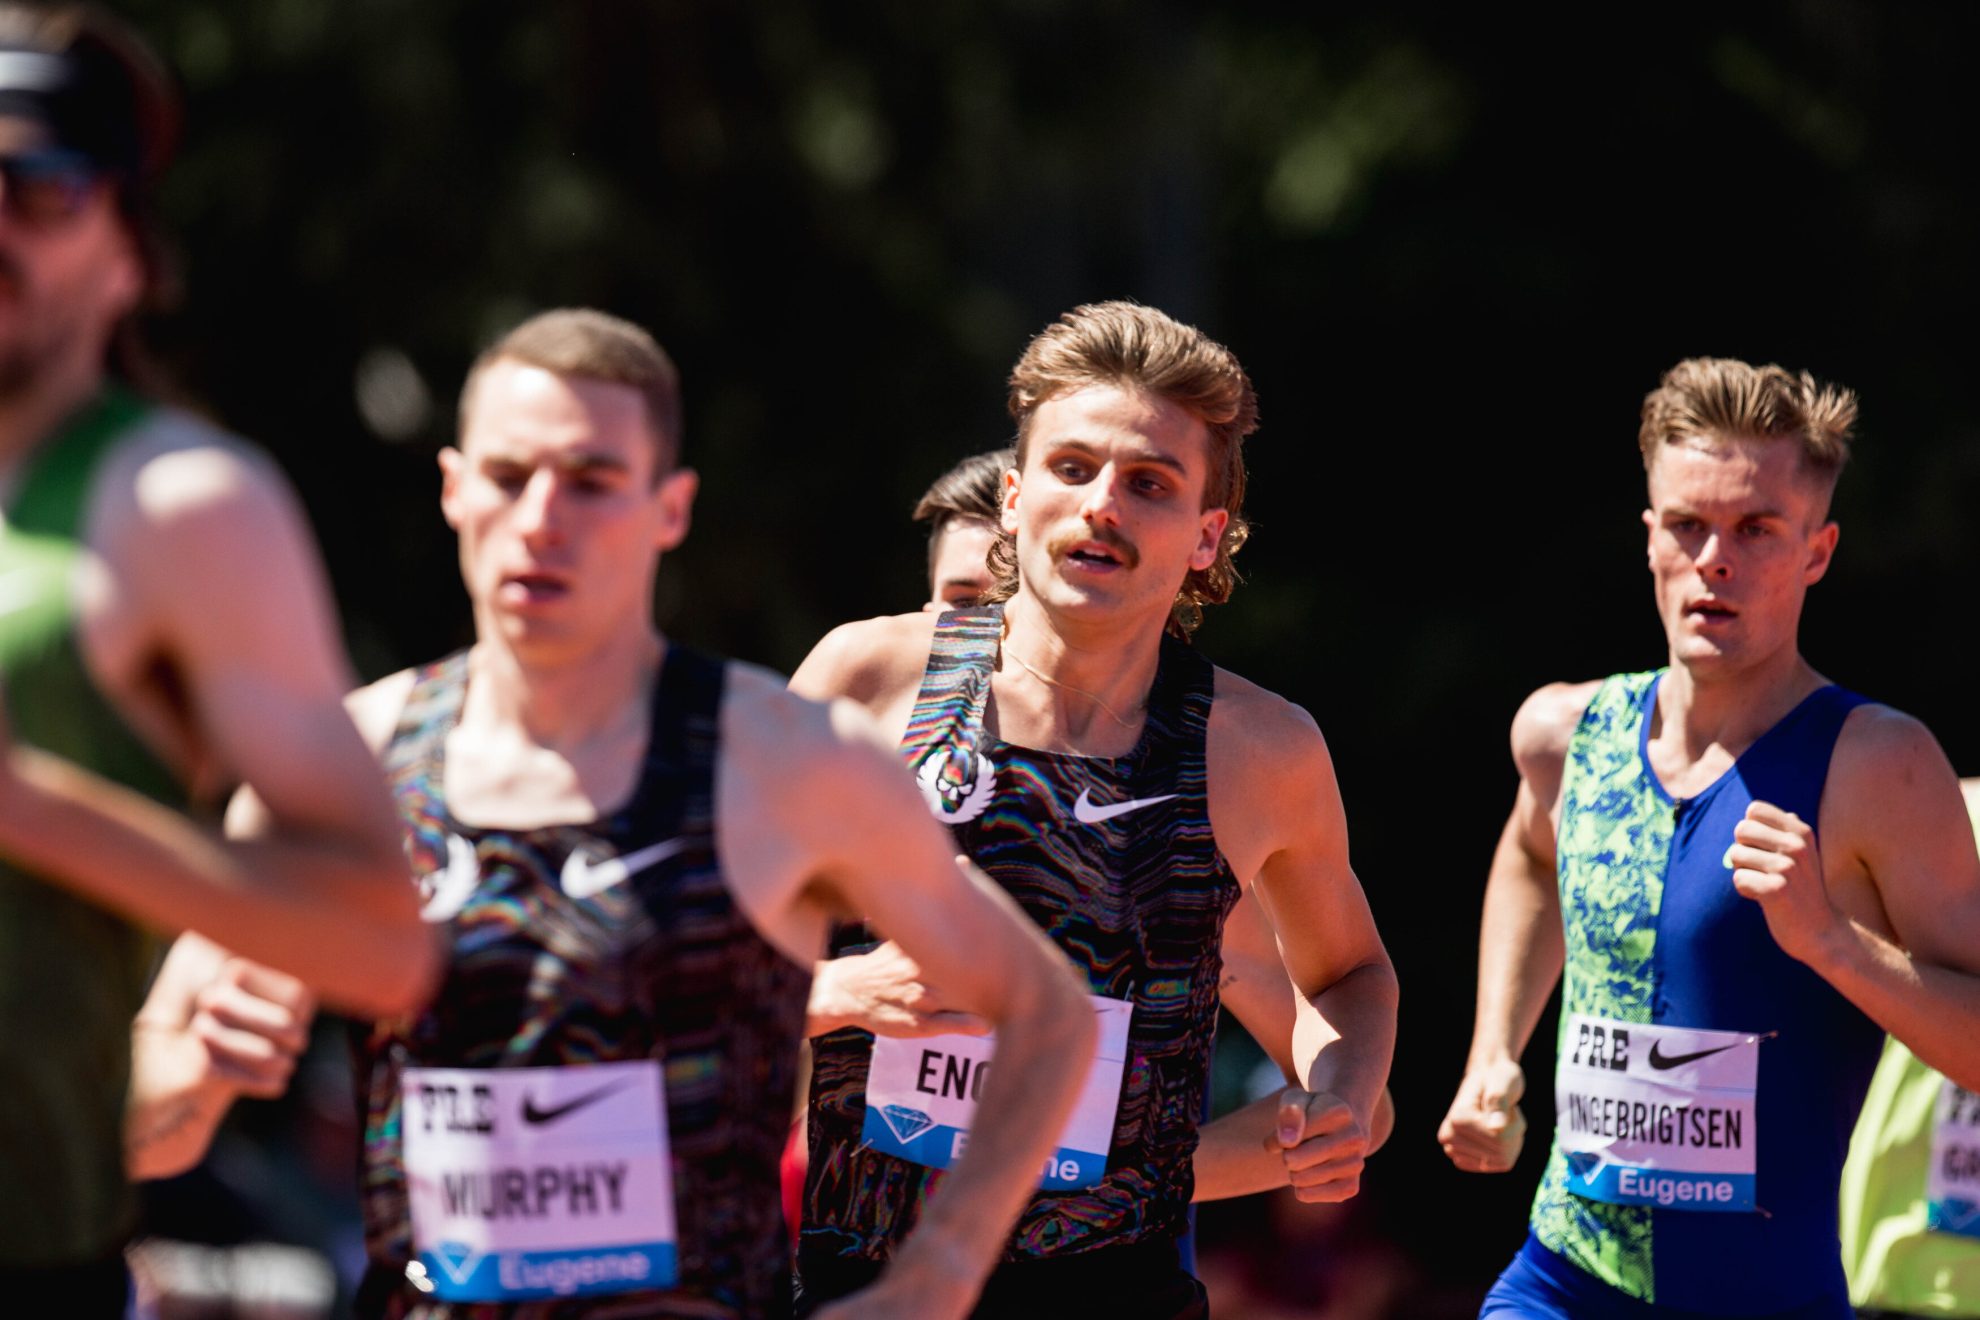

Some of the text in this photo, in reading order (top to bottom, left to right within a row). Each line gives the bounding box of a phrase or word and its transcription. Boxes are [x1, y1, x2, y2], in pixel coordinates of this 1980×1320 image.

[1573, 1023, 1629, 1071] PRE
[1569, 1093, 1742, 1149] INGEBRIGTSEN
[442, 1162, 628, 1219] MURPHY
[1619, 1168, 1733, 1205] Eugene
[499, 1251, 650, 1295] Eugene
